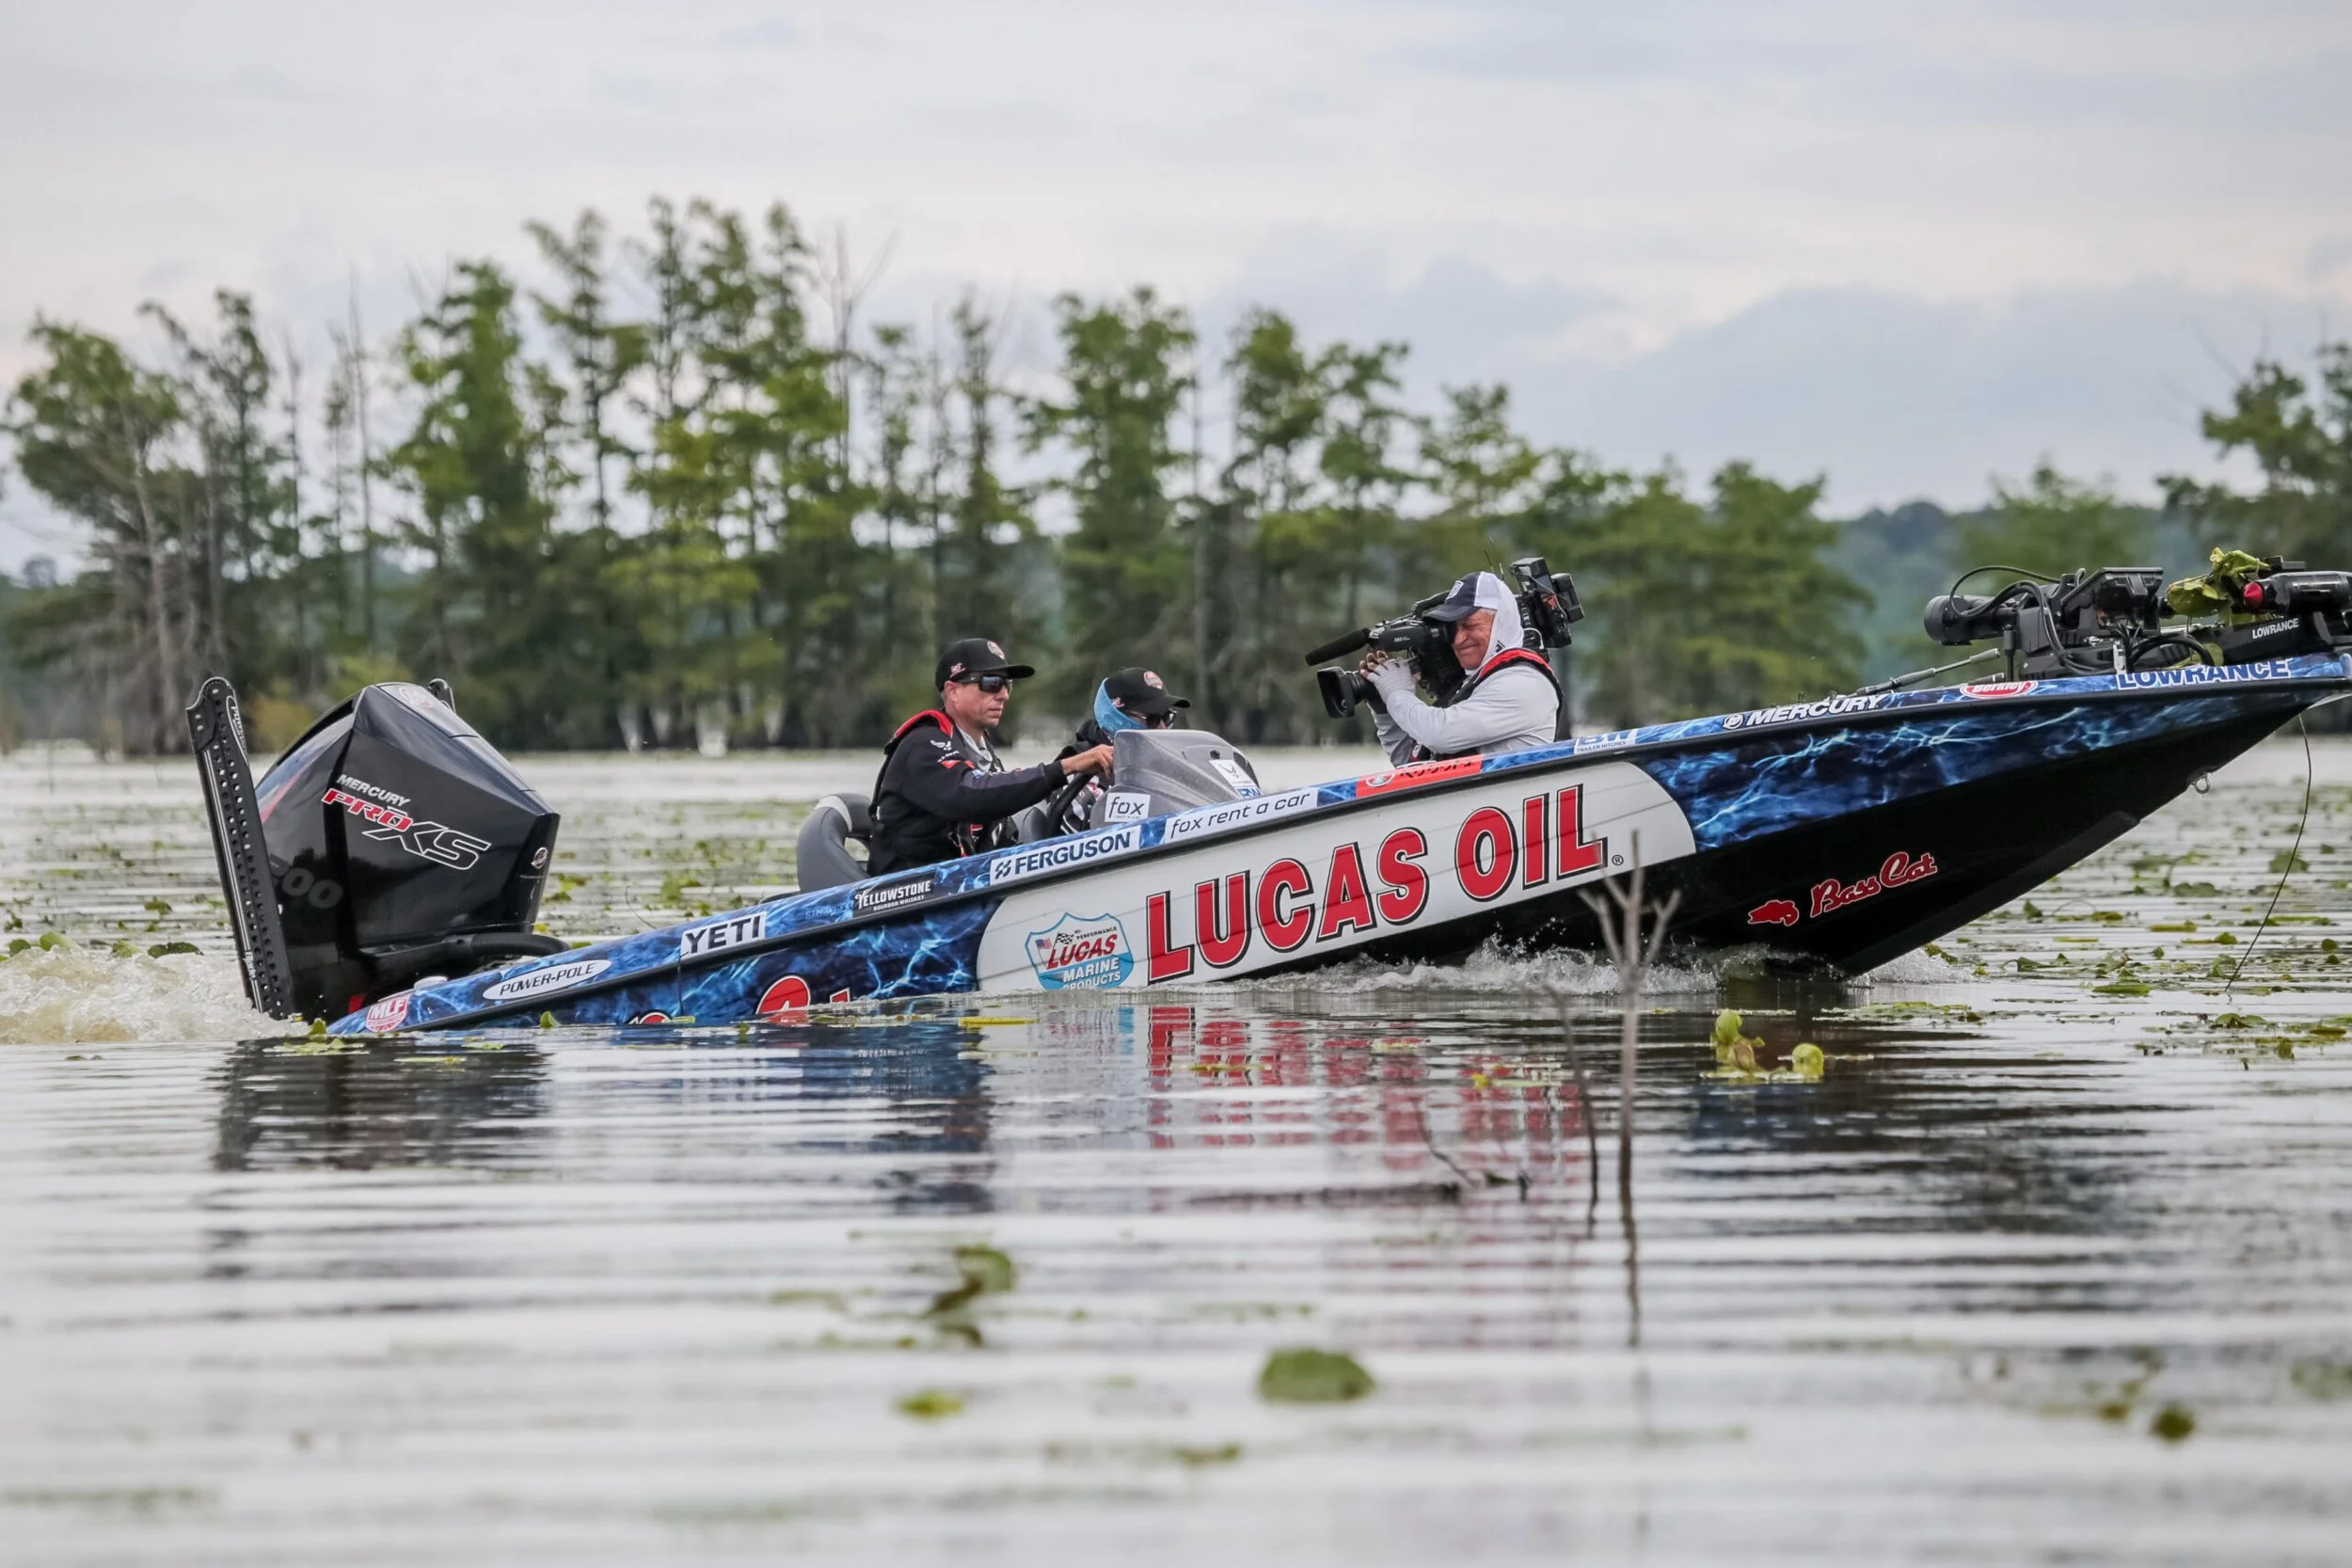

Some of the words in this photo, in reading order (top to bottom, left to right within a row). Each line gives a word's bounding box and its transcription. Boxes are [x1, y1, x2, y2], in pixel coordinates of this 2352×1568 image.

[2252, 617, 2299, 640] LOWRANCE
[2117, 658, 2292, 690] LOWRANCE
[1746, 693, 1889, 726] MERCURY
[1601, 740, 1627, 749] HITCHES
[337, 774, 412, 807] MERCURY
[1108, 796, 1145, 818] fox
[1170, 818, 1203, 839] fox
[1208, 805, 1249, 826] rent
[1256, 801, 1268, 815] a
[1274, 793, 1311, 809] car
[1014, 832, 1131, 875] FERGUSON
[854, 879, 932, 910] YELLOWSTONE
[1146, 827, 1429, 986] LUCAS
[1454, 783, 1609, 903] OIL
[873, 900, 899, 911] BOURBON
[899, 895, 925, 906] WHISKEY
[686, 915, 761, 955] YETI
[1076, 927, 1117, 940] PERFORMANCE
[1046, 934, 1119, 970] LUCAS
[499, 961, 596, 996] POWER-POLE
[1062, 972, 1121, 990] PRODUCTS
[1063, 958, 1120, 983] MARINE
[368, 998, 407, 1021] MLF
